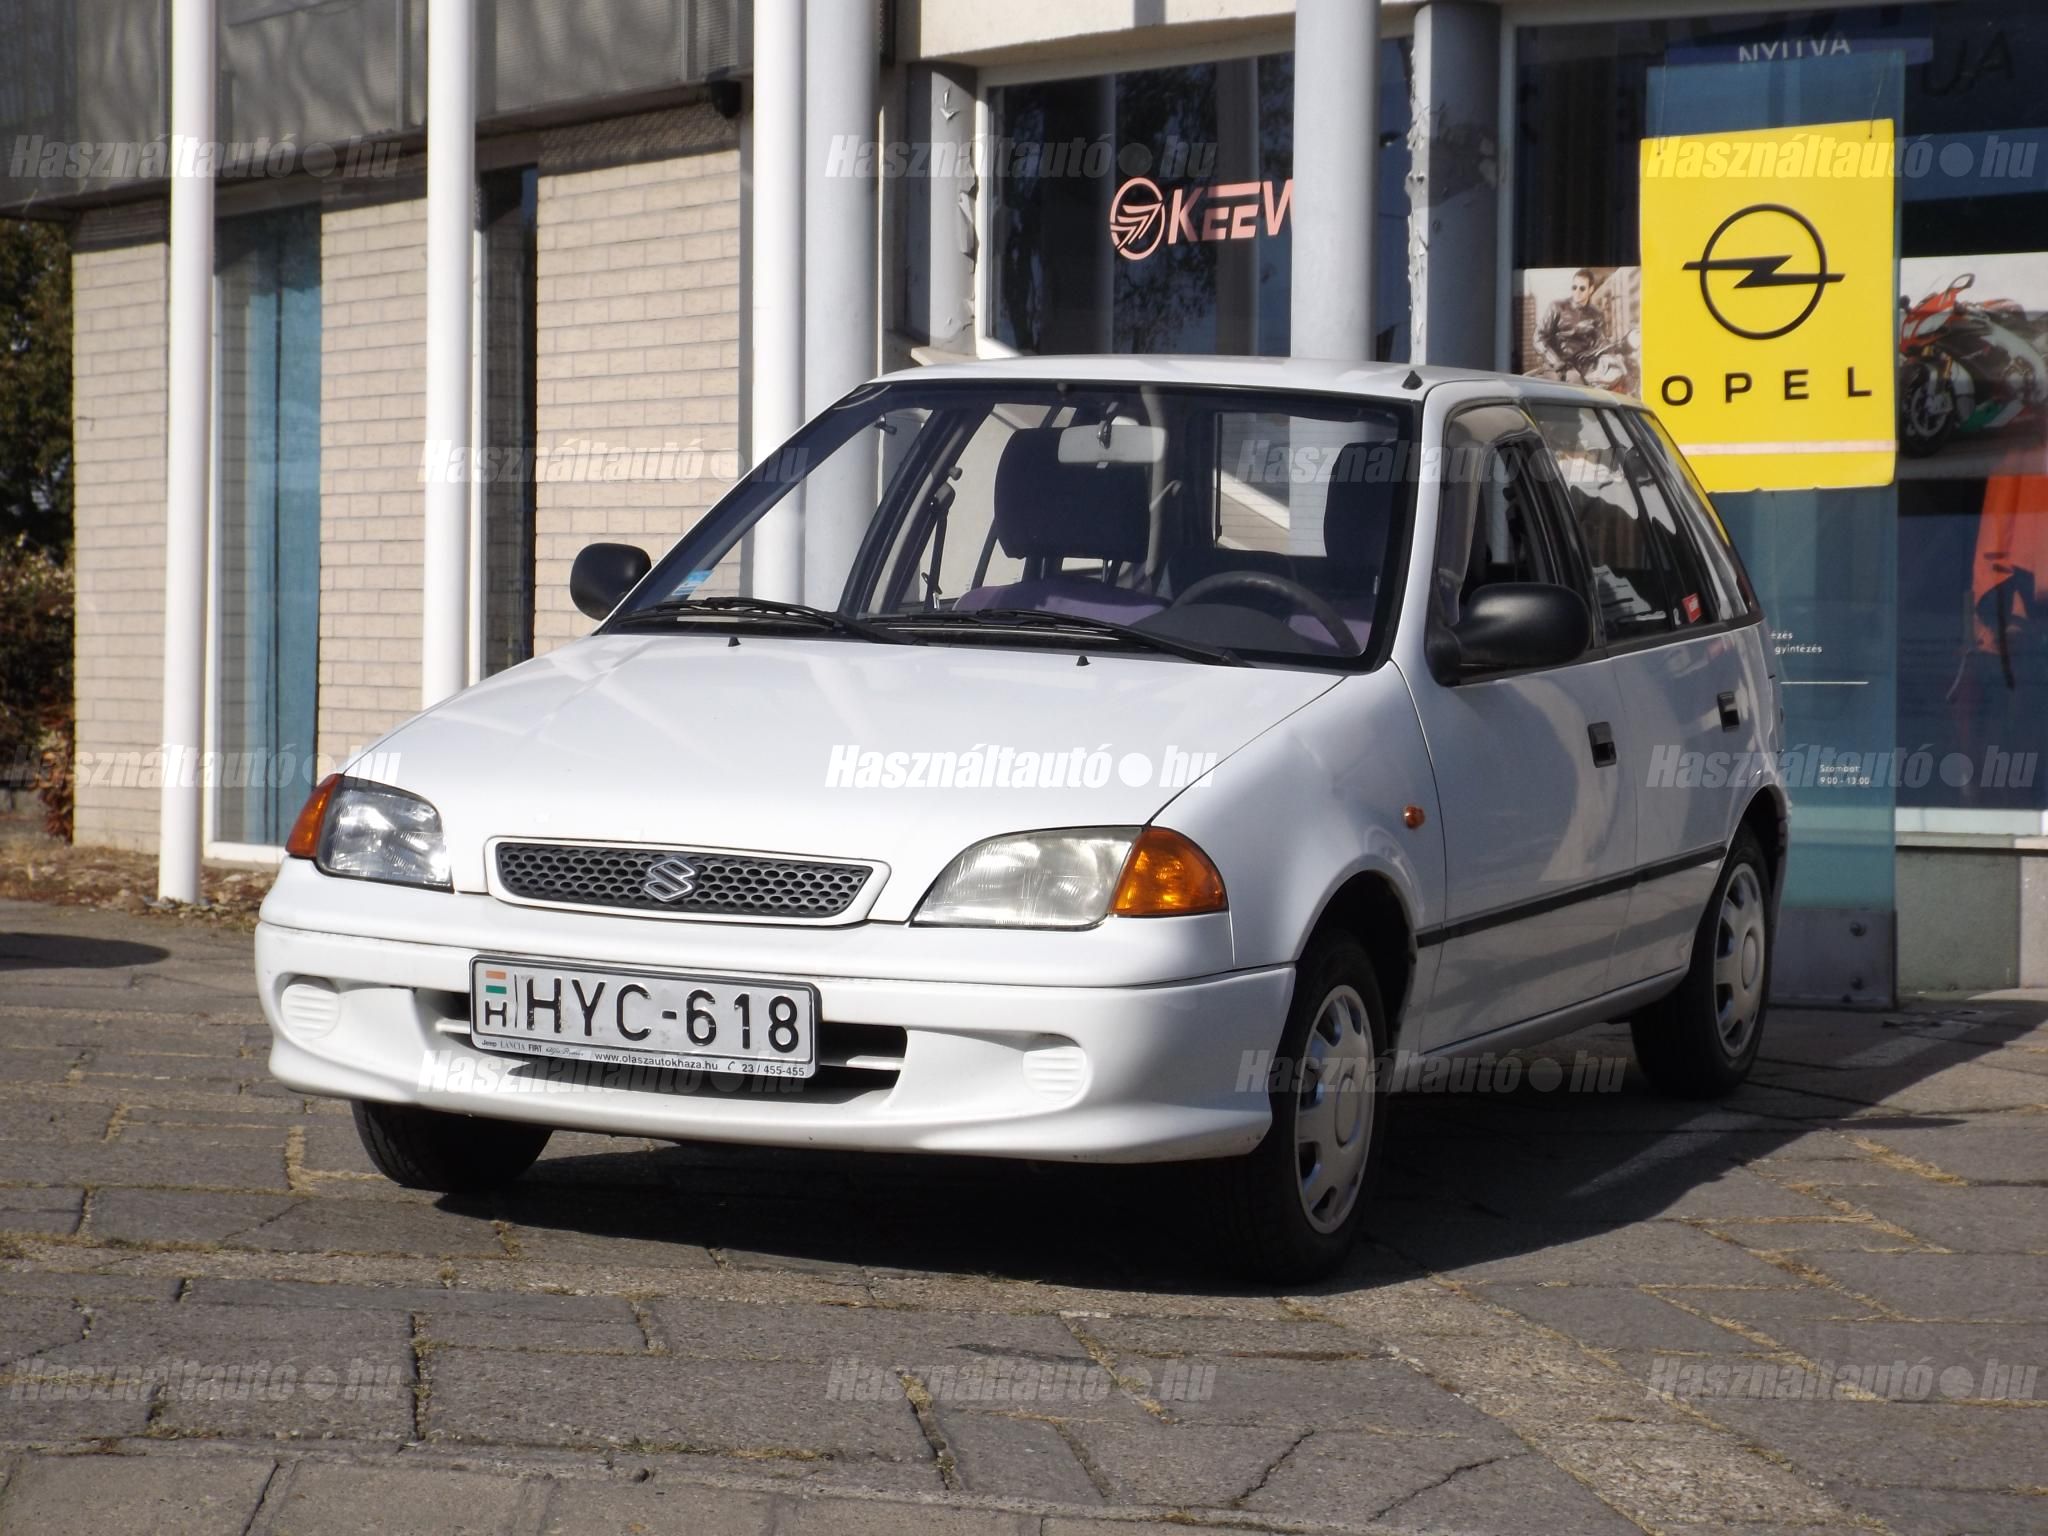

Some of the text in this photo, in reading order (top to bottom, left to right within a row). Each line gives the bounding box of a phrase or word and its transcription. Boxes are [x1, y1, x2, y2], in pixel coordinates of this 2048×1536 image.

[1661, 366, 1872, 406] OPEL
[525, 976, 800, 1054] HYC-618
[594, 1051, 718, 1071] www.olaszautokhaza.hu
[763, 1064, 805, 1077] 455-455
